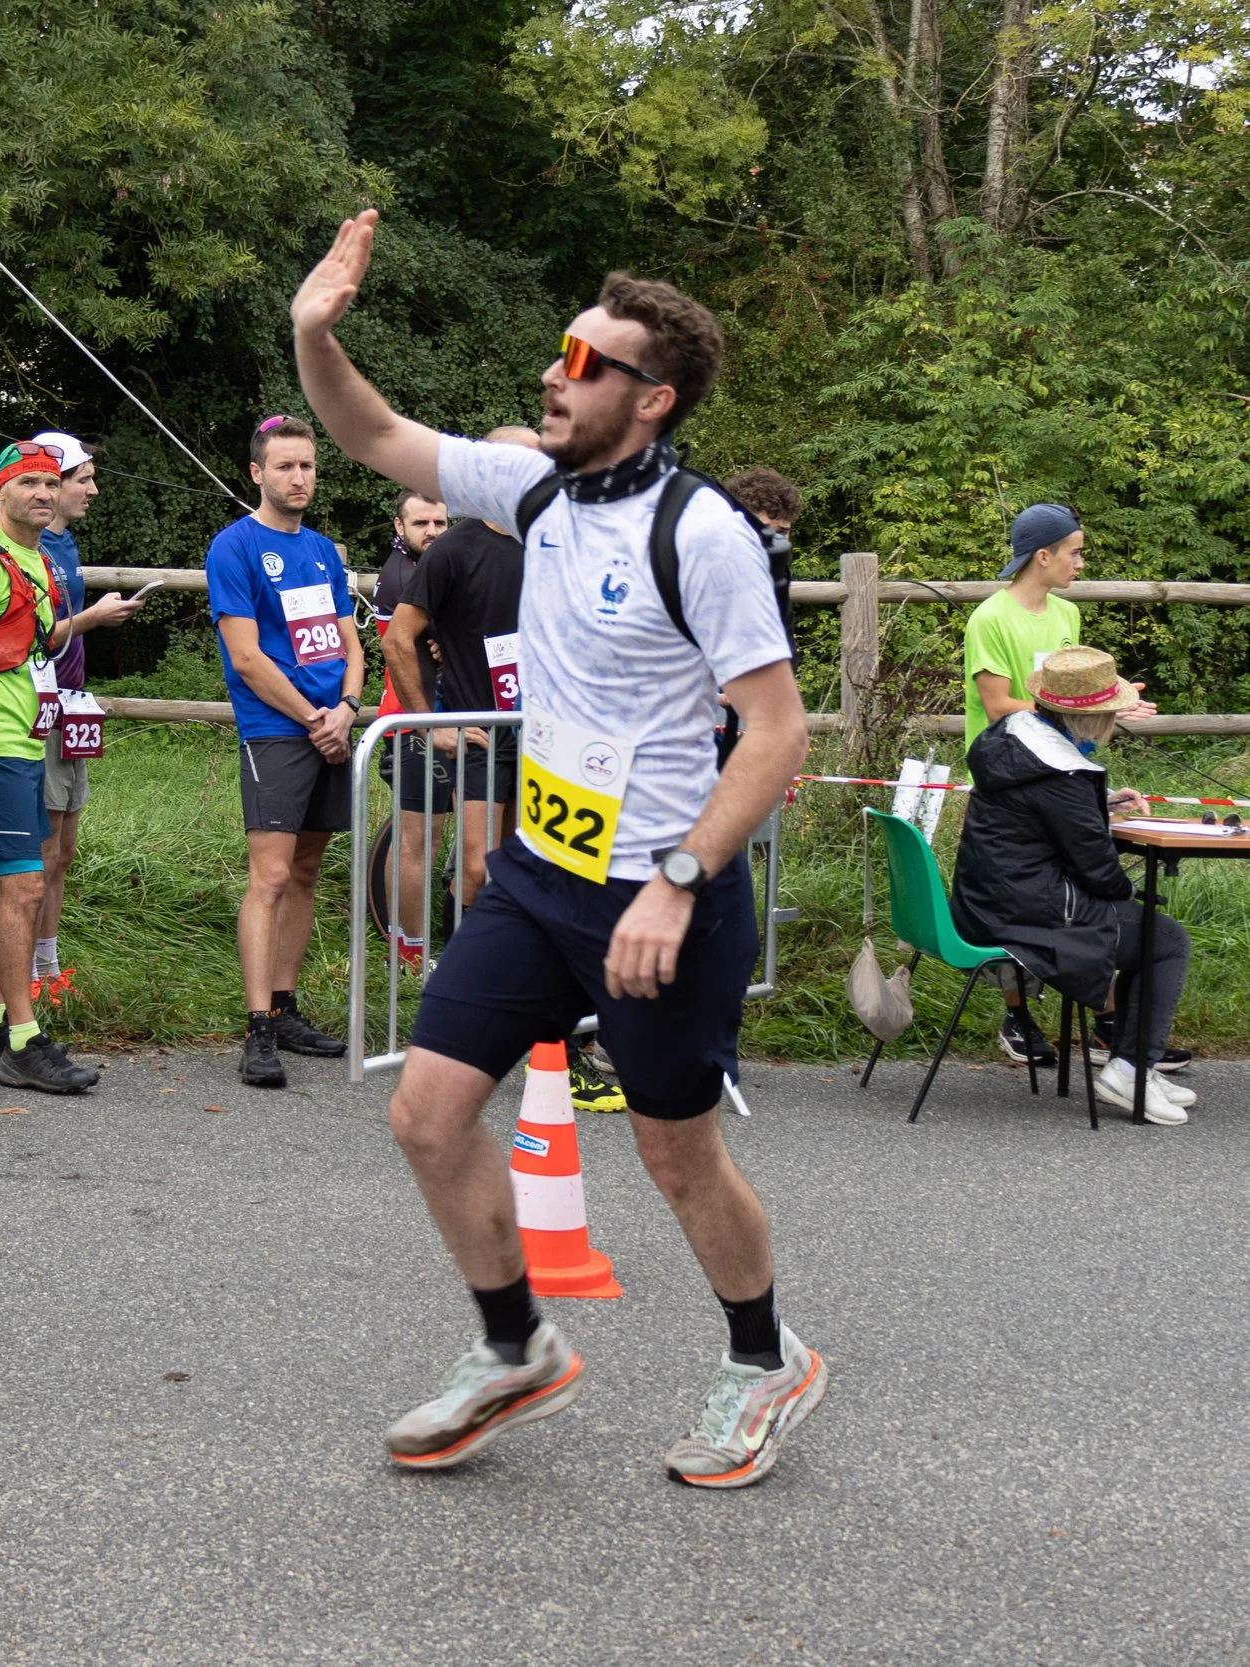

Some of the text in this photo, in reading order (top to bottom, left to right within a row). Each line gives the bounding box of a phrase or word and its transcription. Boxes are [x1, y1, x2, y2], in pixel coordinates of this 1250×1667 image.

[295, 623, 341, 655] 298
[498, 673, 519, 699] 3
[65, 723, 101, 748] 323
[526, 778, 605, 859] 322
